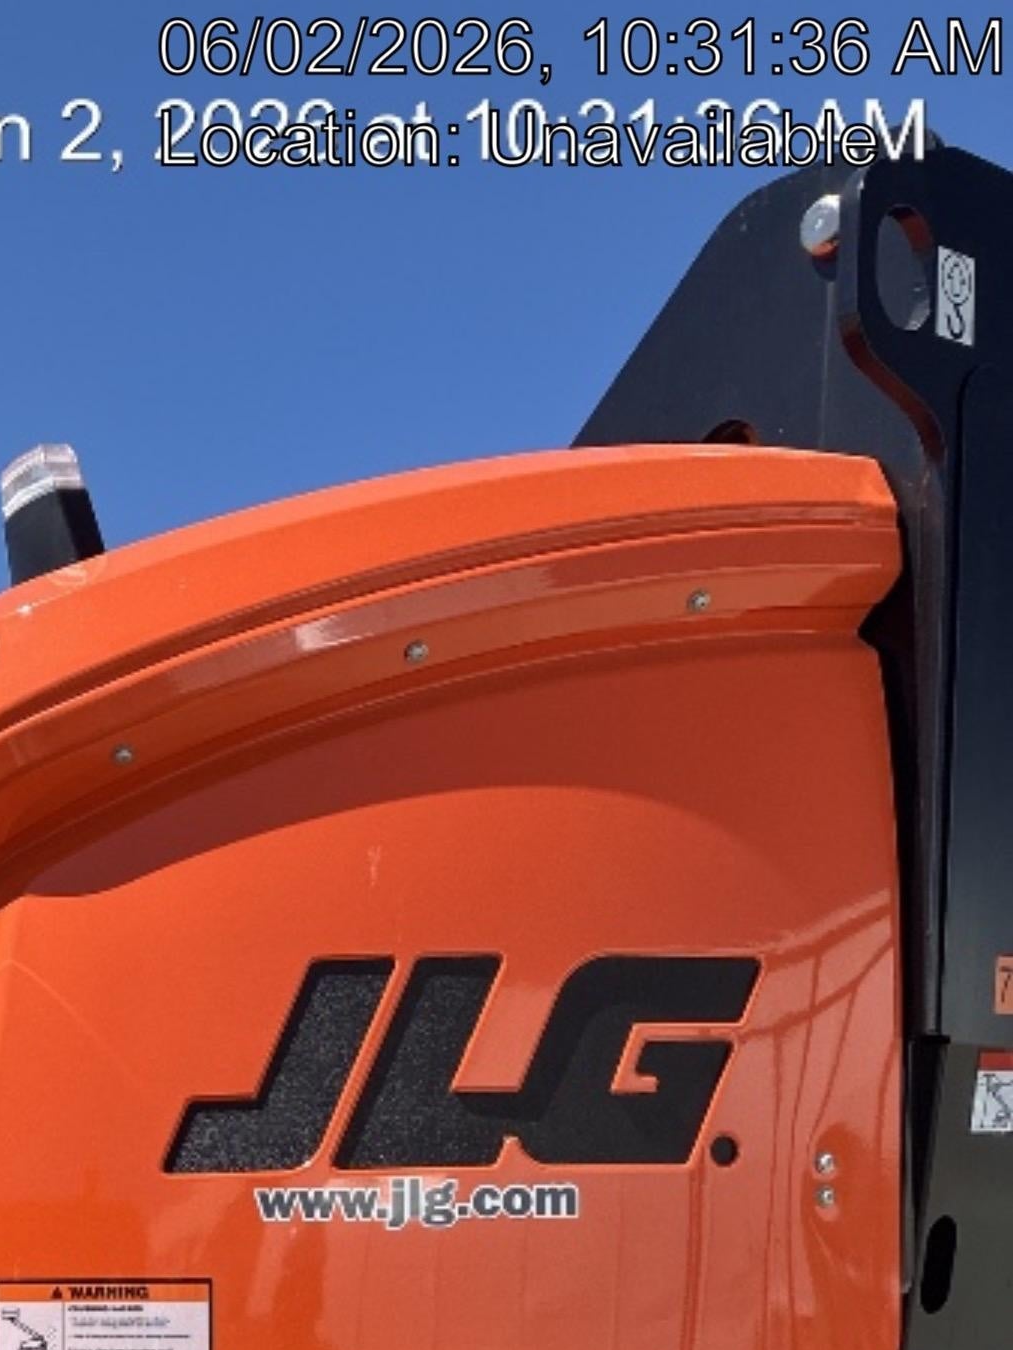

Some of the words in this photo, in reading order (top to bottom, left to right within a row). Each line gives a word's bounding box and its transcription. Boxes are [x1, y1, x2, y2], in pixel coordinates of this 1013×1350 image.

[161, 952, 763, 1174] JLG
[254, 1176, 580, 1230] www.jlg.com
[68, 1285, 150, 1300] WARNING
